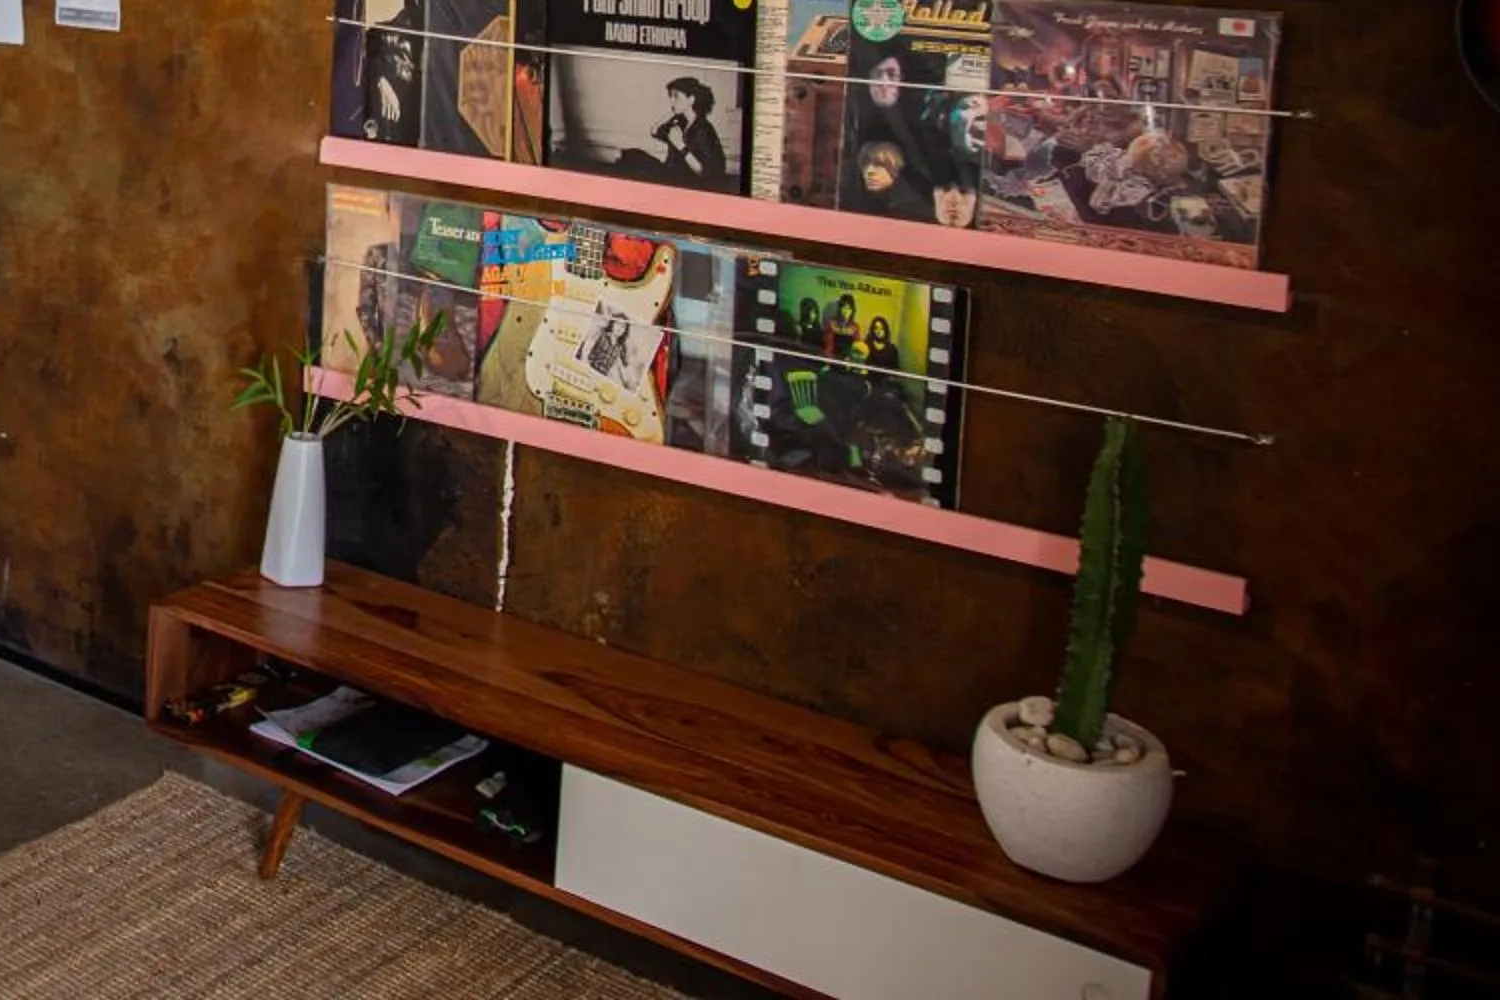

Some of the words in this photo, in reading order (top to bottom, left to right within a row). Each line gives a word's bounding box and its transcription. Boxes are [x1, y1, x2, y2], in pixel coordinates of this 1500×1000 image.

[605, 21, 638, 44] RADIO
[639, 25, 687, 49] ETHIOPIA
[817, 275, 836, 288] The
[838, 278, 855, 290] Yes
[857, 281, 893, 297] Album
